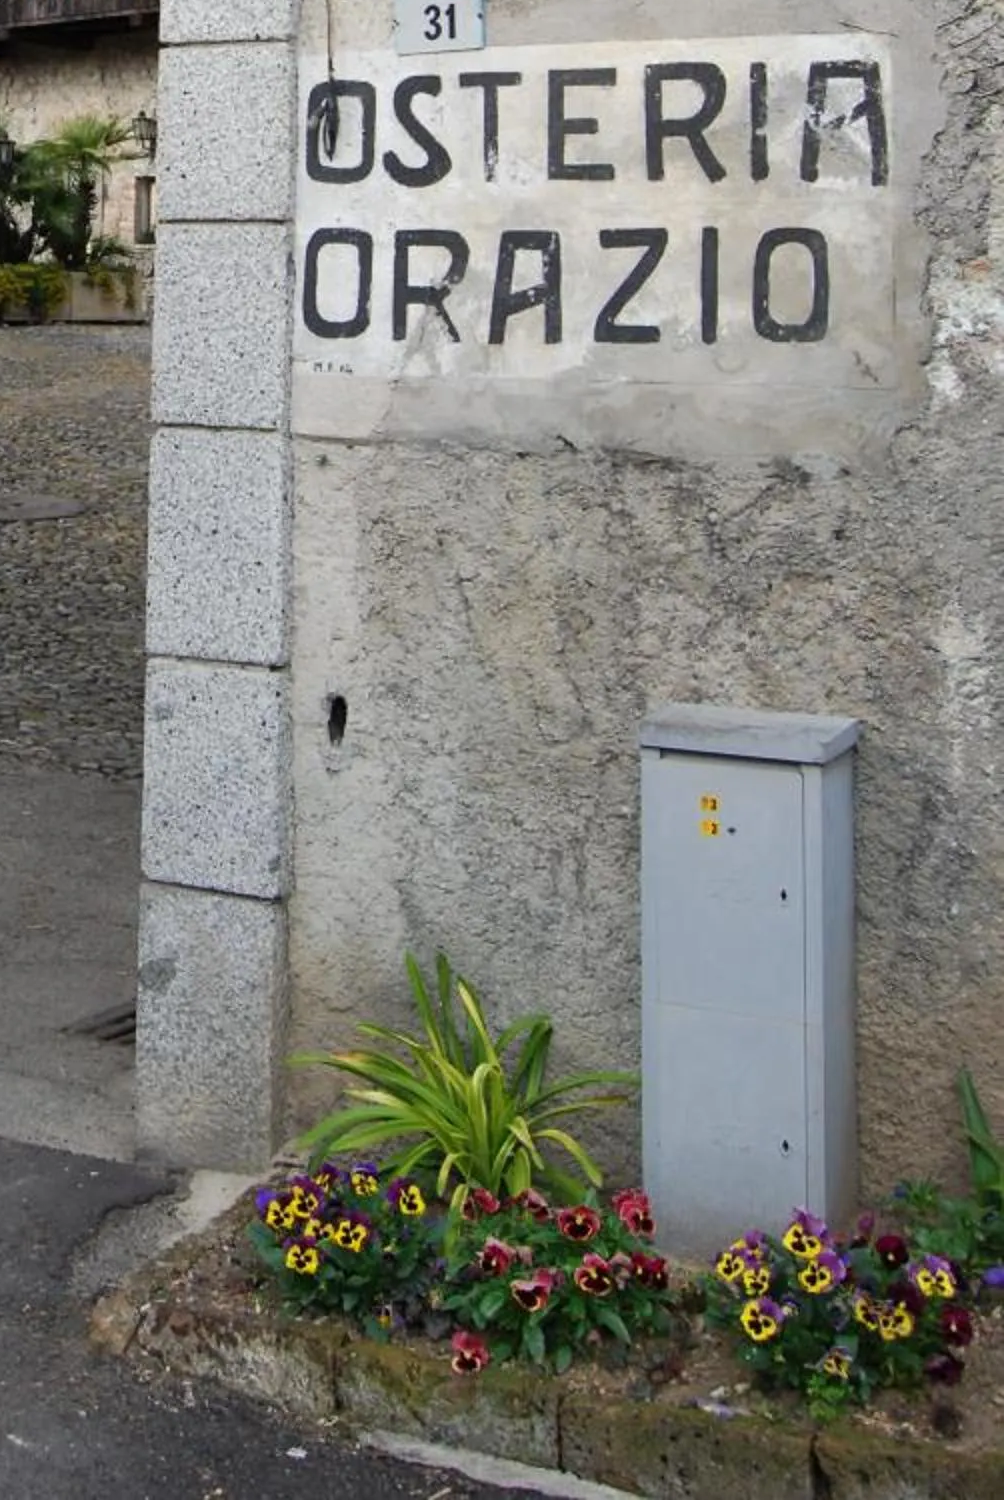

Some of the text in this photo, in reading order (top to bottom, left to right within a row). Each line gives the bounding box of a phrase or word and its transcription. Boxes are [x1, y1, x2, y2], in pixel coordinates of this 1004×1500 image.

[423, 3, 456, 41] 31
[304, 61, 890, 188] OSTERIA
[302, 227, 830, 345] ORAZIO
